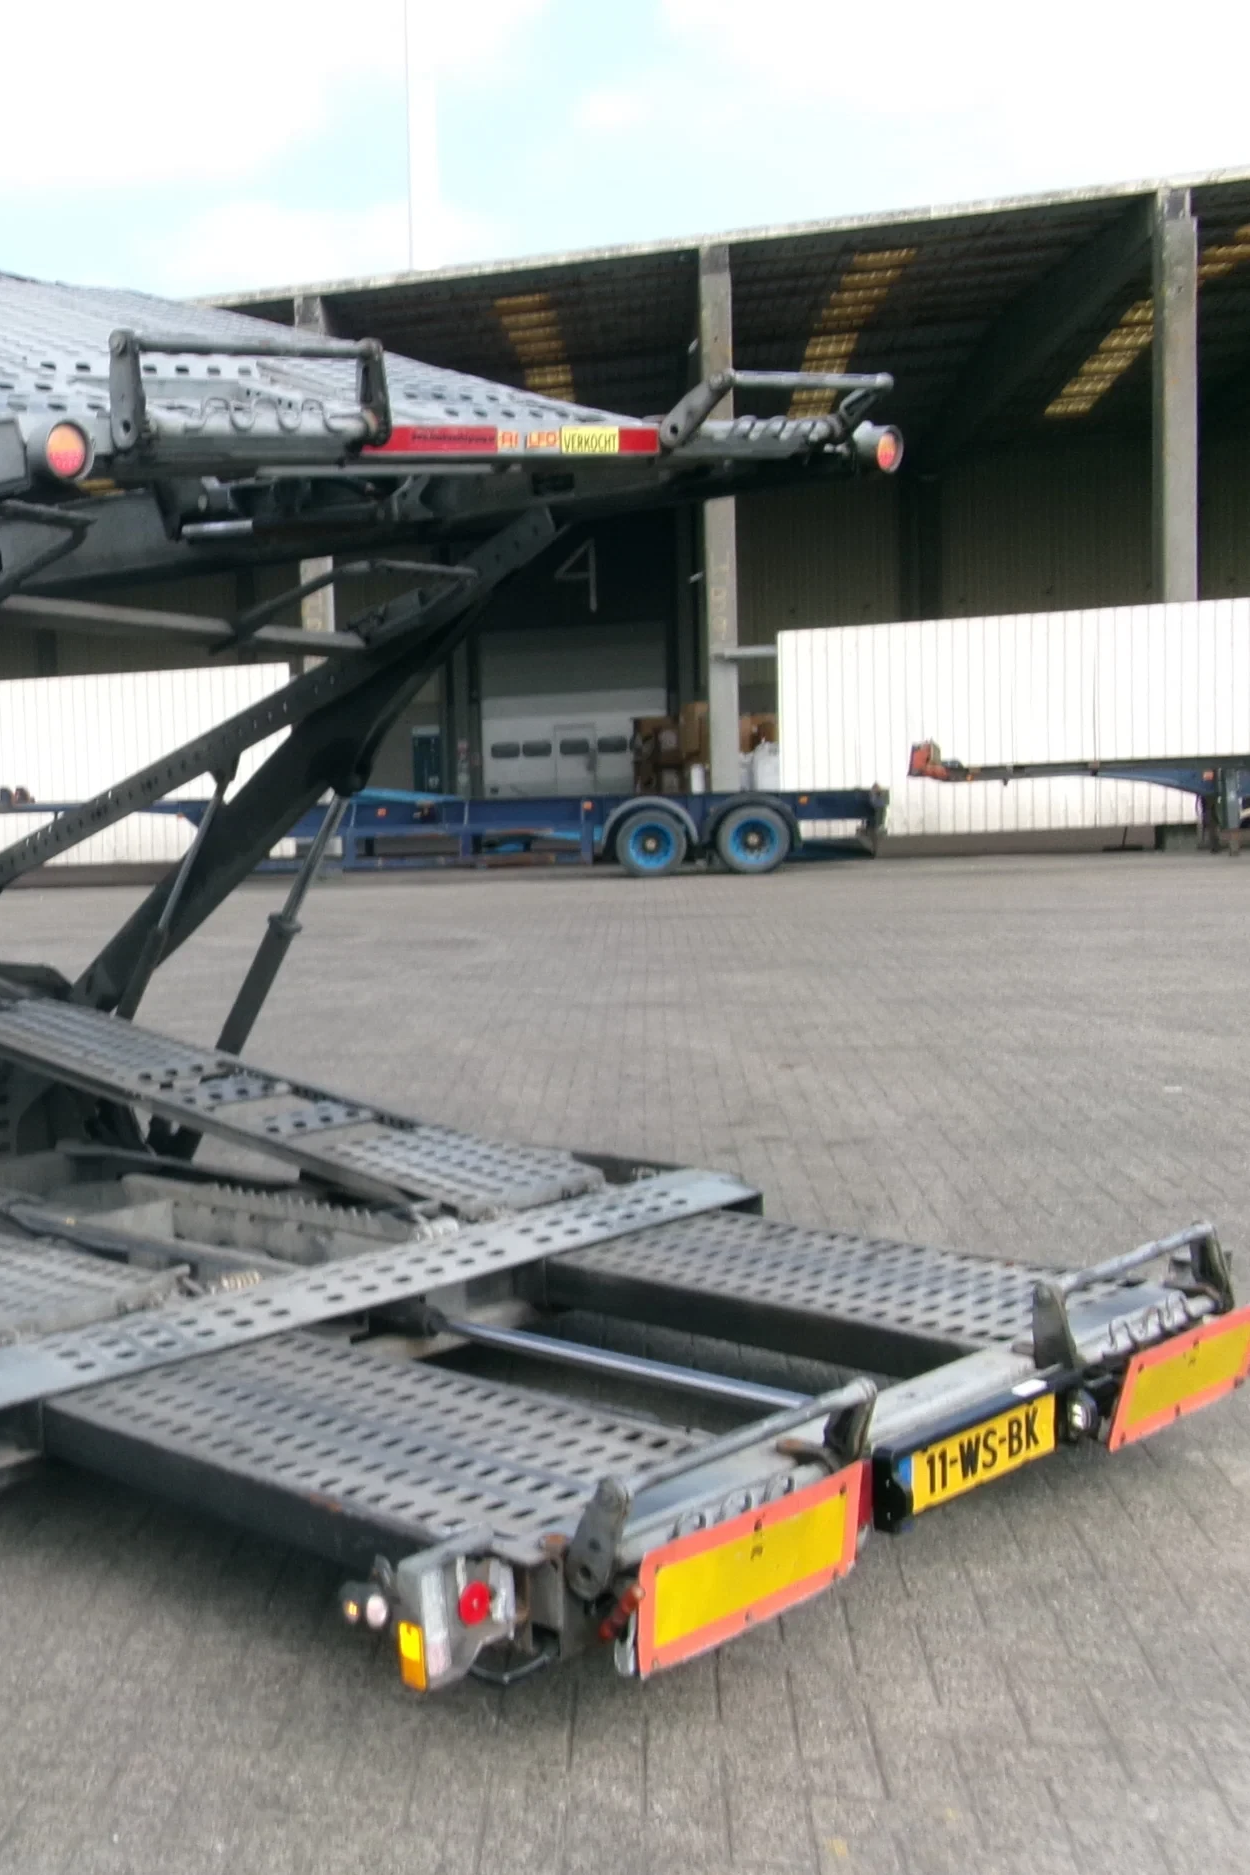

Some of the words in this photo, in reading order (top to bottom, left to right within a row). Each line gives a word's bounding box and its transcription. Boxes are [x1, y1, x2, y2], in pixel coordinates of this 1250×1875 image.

[564, 432, 618, 453] VERKOCHT
[554, 538, 597, 612] 4
[926, 1406, 1040, 1494] 11-WS-BK
